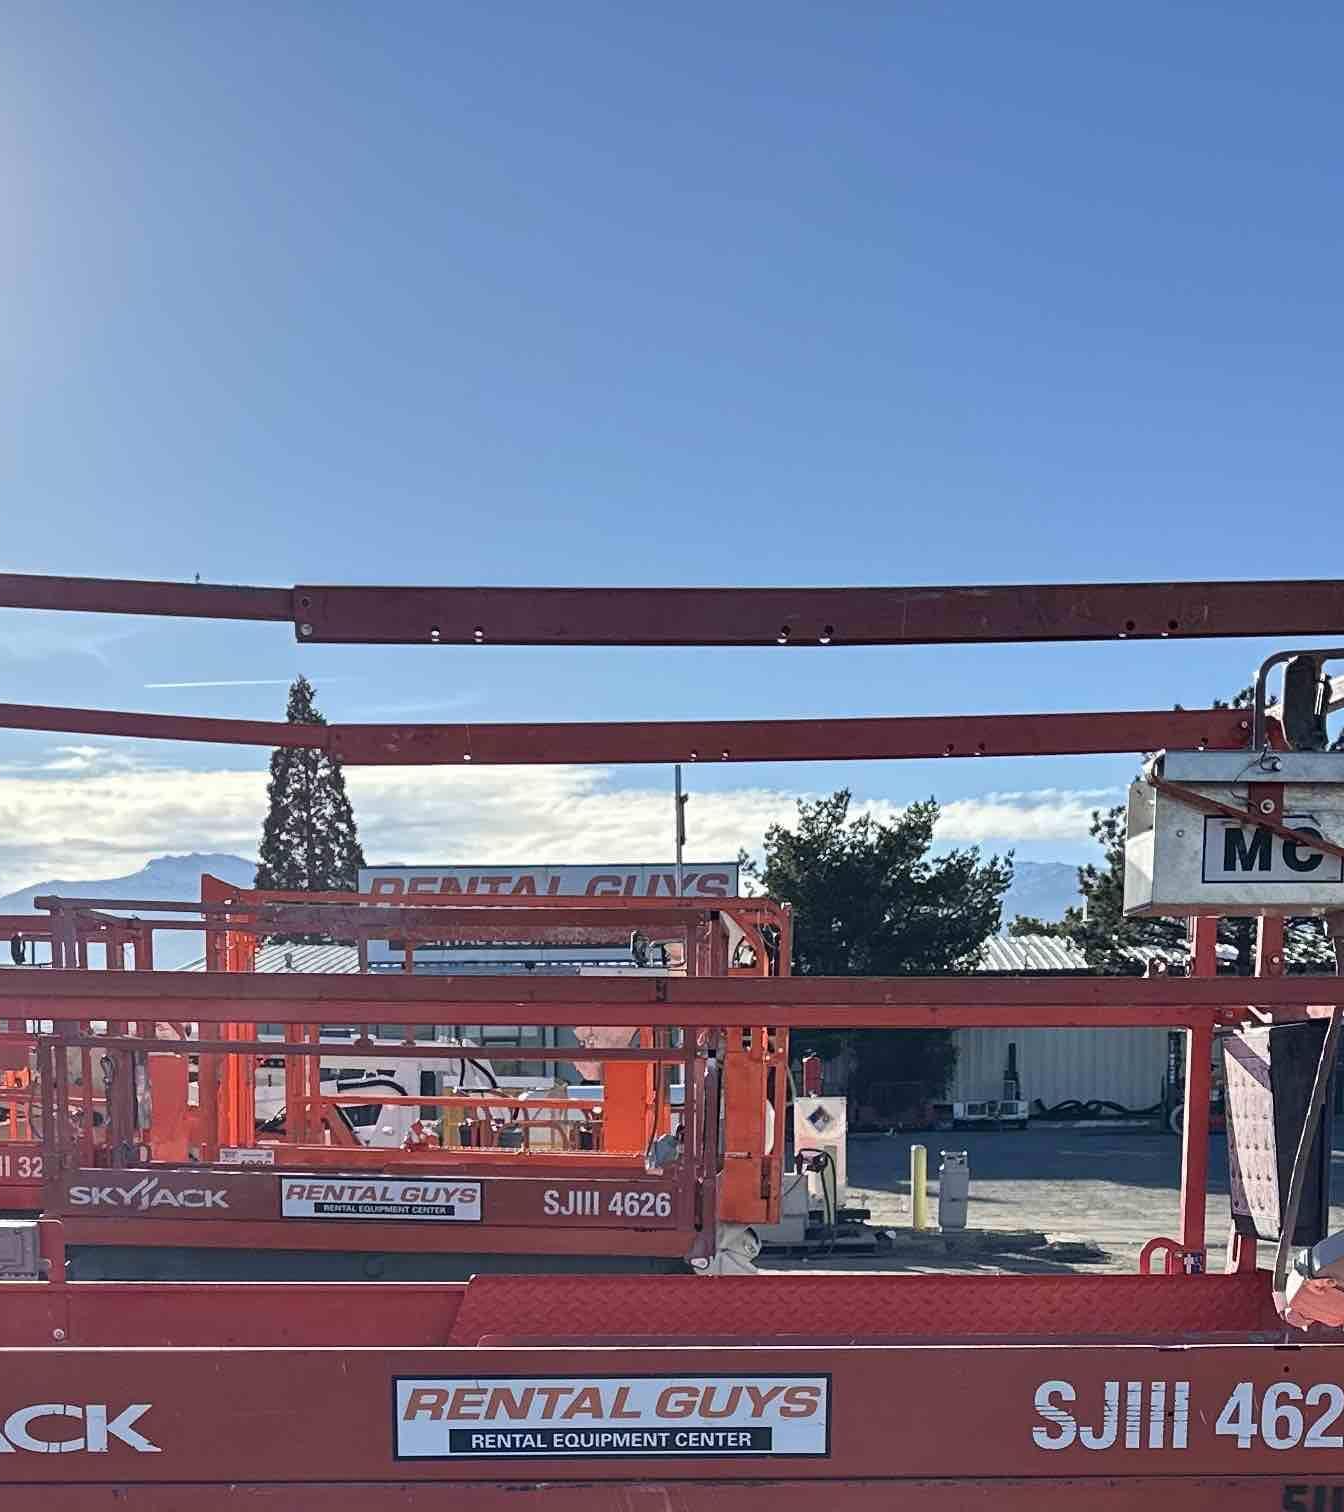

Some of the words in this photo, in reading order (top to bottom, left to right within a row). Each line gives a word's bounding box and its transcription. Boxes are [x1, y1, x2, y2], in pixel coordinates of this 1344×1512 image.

[1224, 827, 1324, 872] MC
[584, 873, 730, 896] GUYS
[18, 1156, 44, 1178] 32
[69, 1177, 230, 1210] SKYJACK
[285, 1184, 394, 1202] RENTAL
[399, 1187, 478, 1204] GUYS
[543, 1190, 600, 1216] SJIII
[608, 1191, 672, 1217] 4626
[323, 1204, 356, 1213] RENTAL
[358, 1205, 410, 1214] EQUIPMENT
[411, 1206, 448, 1215] CENTER
[402, 1386, 642, 1422] RENTAL
[656, 1385, 822, 1420] GUYS
[1032, 1380, 1190, 1451] SJIII
[471, 1433, 548, 1450] RENTAL
[552, 1432, 669, 1450] EQUIPMENT
[674, 1431, 752, 1448] CENTER
